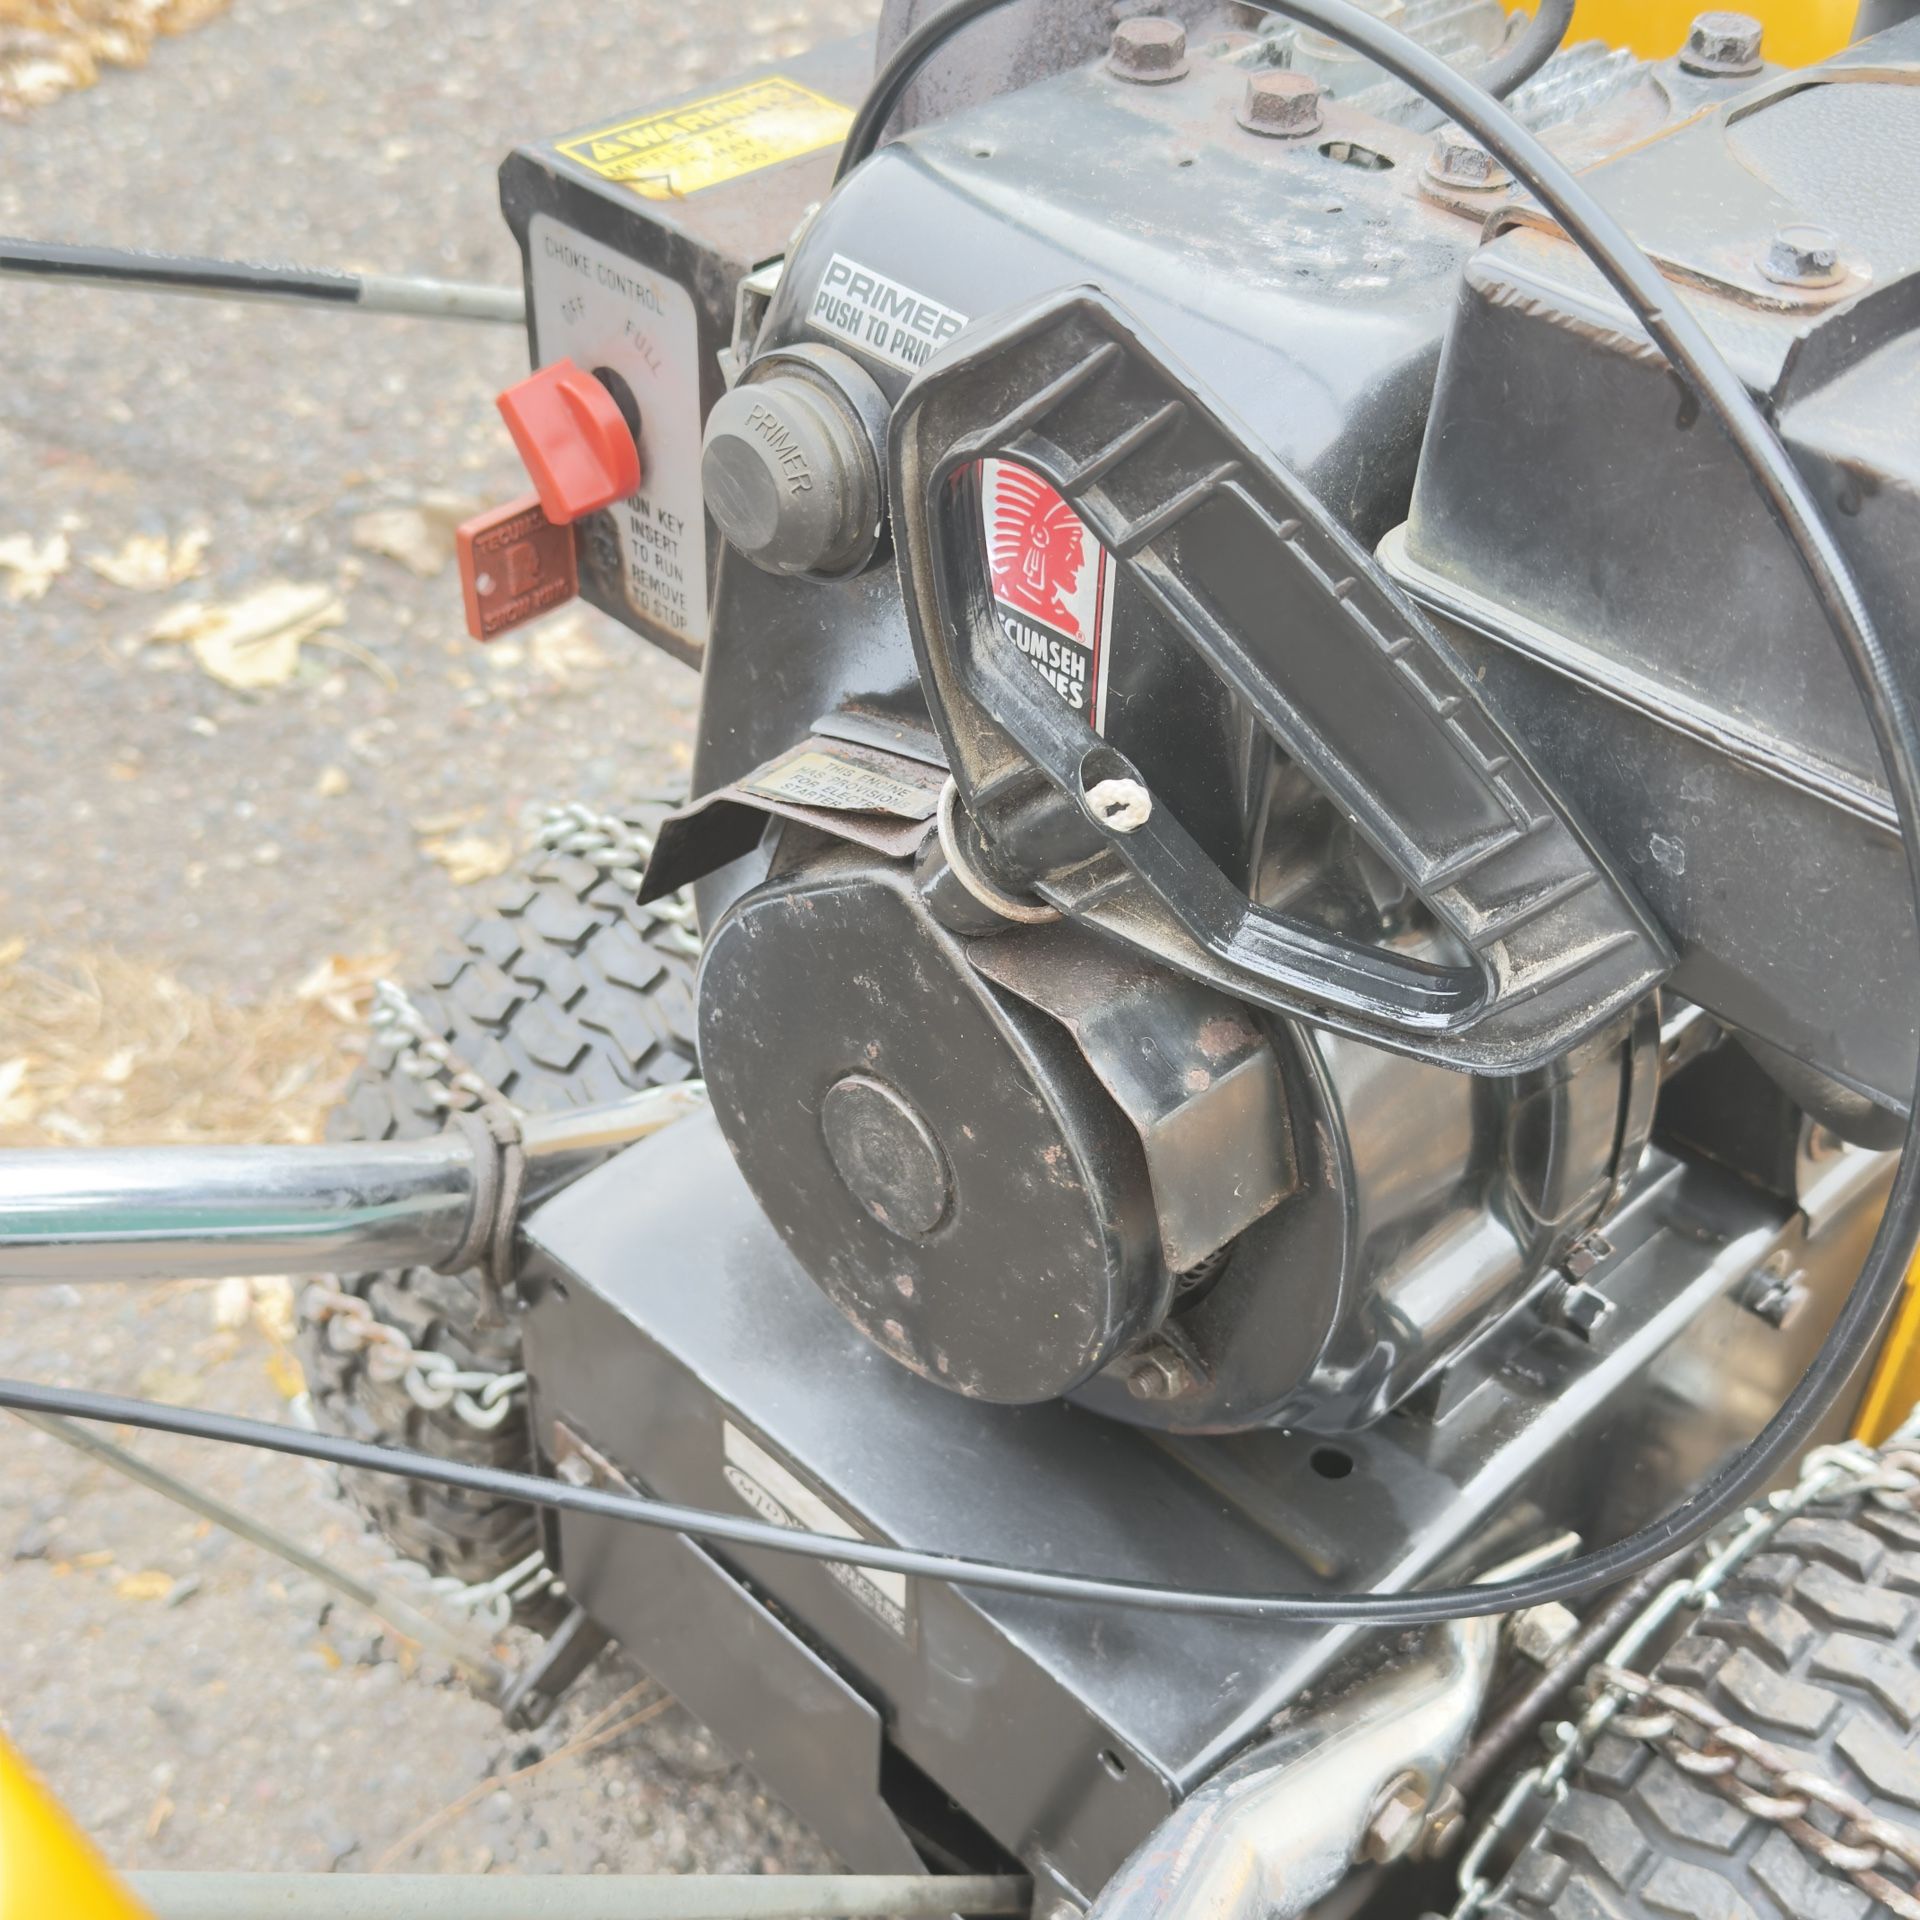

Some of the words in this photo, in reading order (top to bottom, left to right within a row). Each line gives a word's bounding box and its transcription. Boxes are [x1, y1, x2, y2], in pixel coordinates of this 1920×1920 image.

[545, 235, 591, 278] CHOKE
[598, 263, 664, 316] CONTROL
[813, 290, 864, 336] PUSH
[865, 314, 890, 349] TO
[824, 261, 963, 341] PRIMER
[625, 320, 662, 378] FULL
[745, 403, 814, 497] PRIMER
[630, 515, 678, 558] INSERT
[658, 507, 684, 537] KEY
[632, 539, 649, 563] TO
[655, 553, 683, 584] RUN
[631, 563, 687, 611] REMOVE
[632, 585, 649, 611] TO
[653, 599, 687, 631] STOP
[781, 782, 843, 807] STARTER
[791, 774, 820, 788] FOR
[798, 767, 826, 779] HAS
[832, 776, 912, 809] PROVISIONS
[824, 762, 856, 777] THIS
[859, 774, 912, 798] ENGINE
